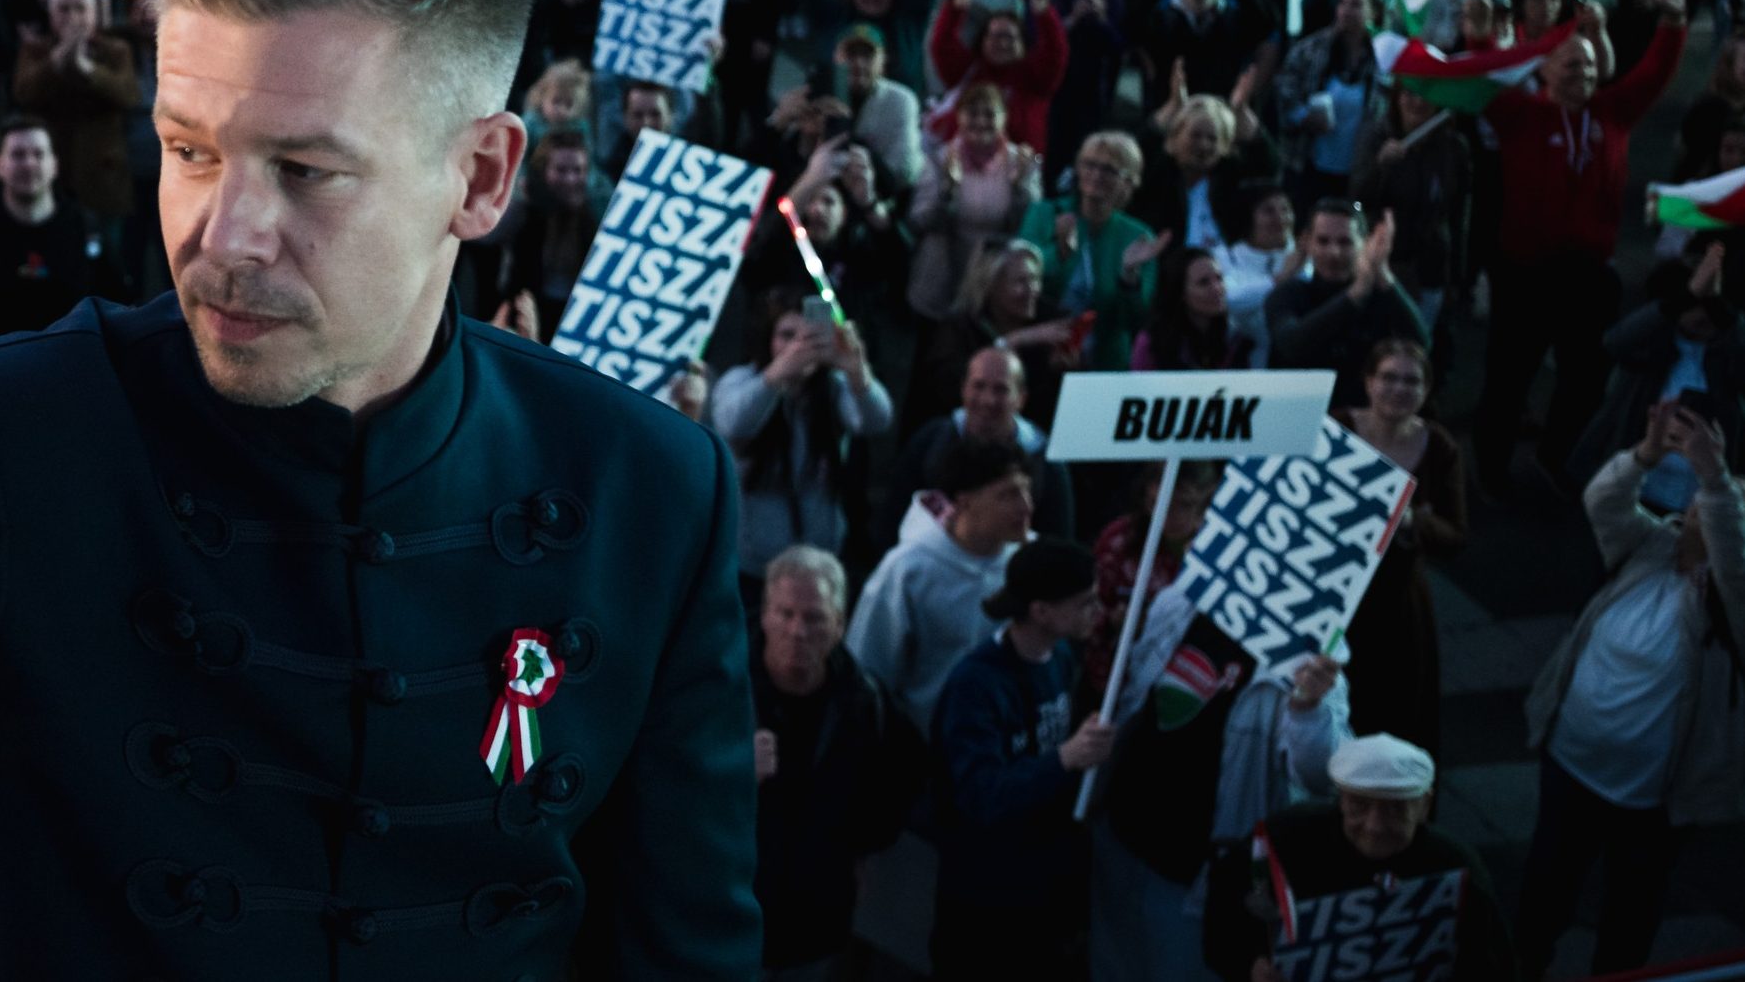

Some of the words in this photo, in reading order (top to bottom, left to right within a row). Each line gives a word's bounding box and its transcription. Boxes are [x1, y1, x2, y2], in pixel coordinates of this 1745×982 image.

[593, 40, 709, 92] TISZA
[599, 5, 717, 54] TISZA
[625, 128, 773, 218] TISZA
[604, 180, 754, 267] TISZA
[582, 232, 739, 318] TISZA
[561, 283, 716, 362] TISZA
[1114, 389, 1260, 441] BUJÁK
[1230, 456, 1390, 565] ISZA
[1314, 424, 1415, 515] SZA
[1191, 509, 1347, 654] TISZA
[1213, 465, 1371, 613] TISZA
[1273, 920, 1457, 982] TISZA
